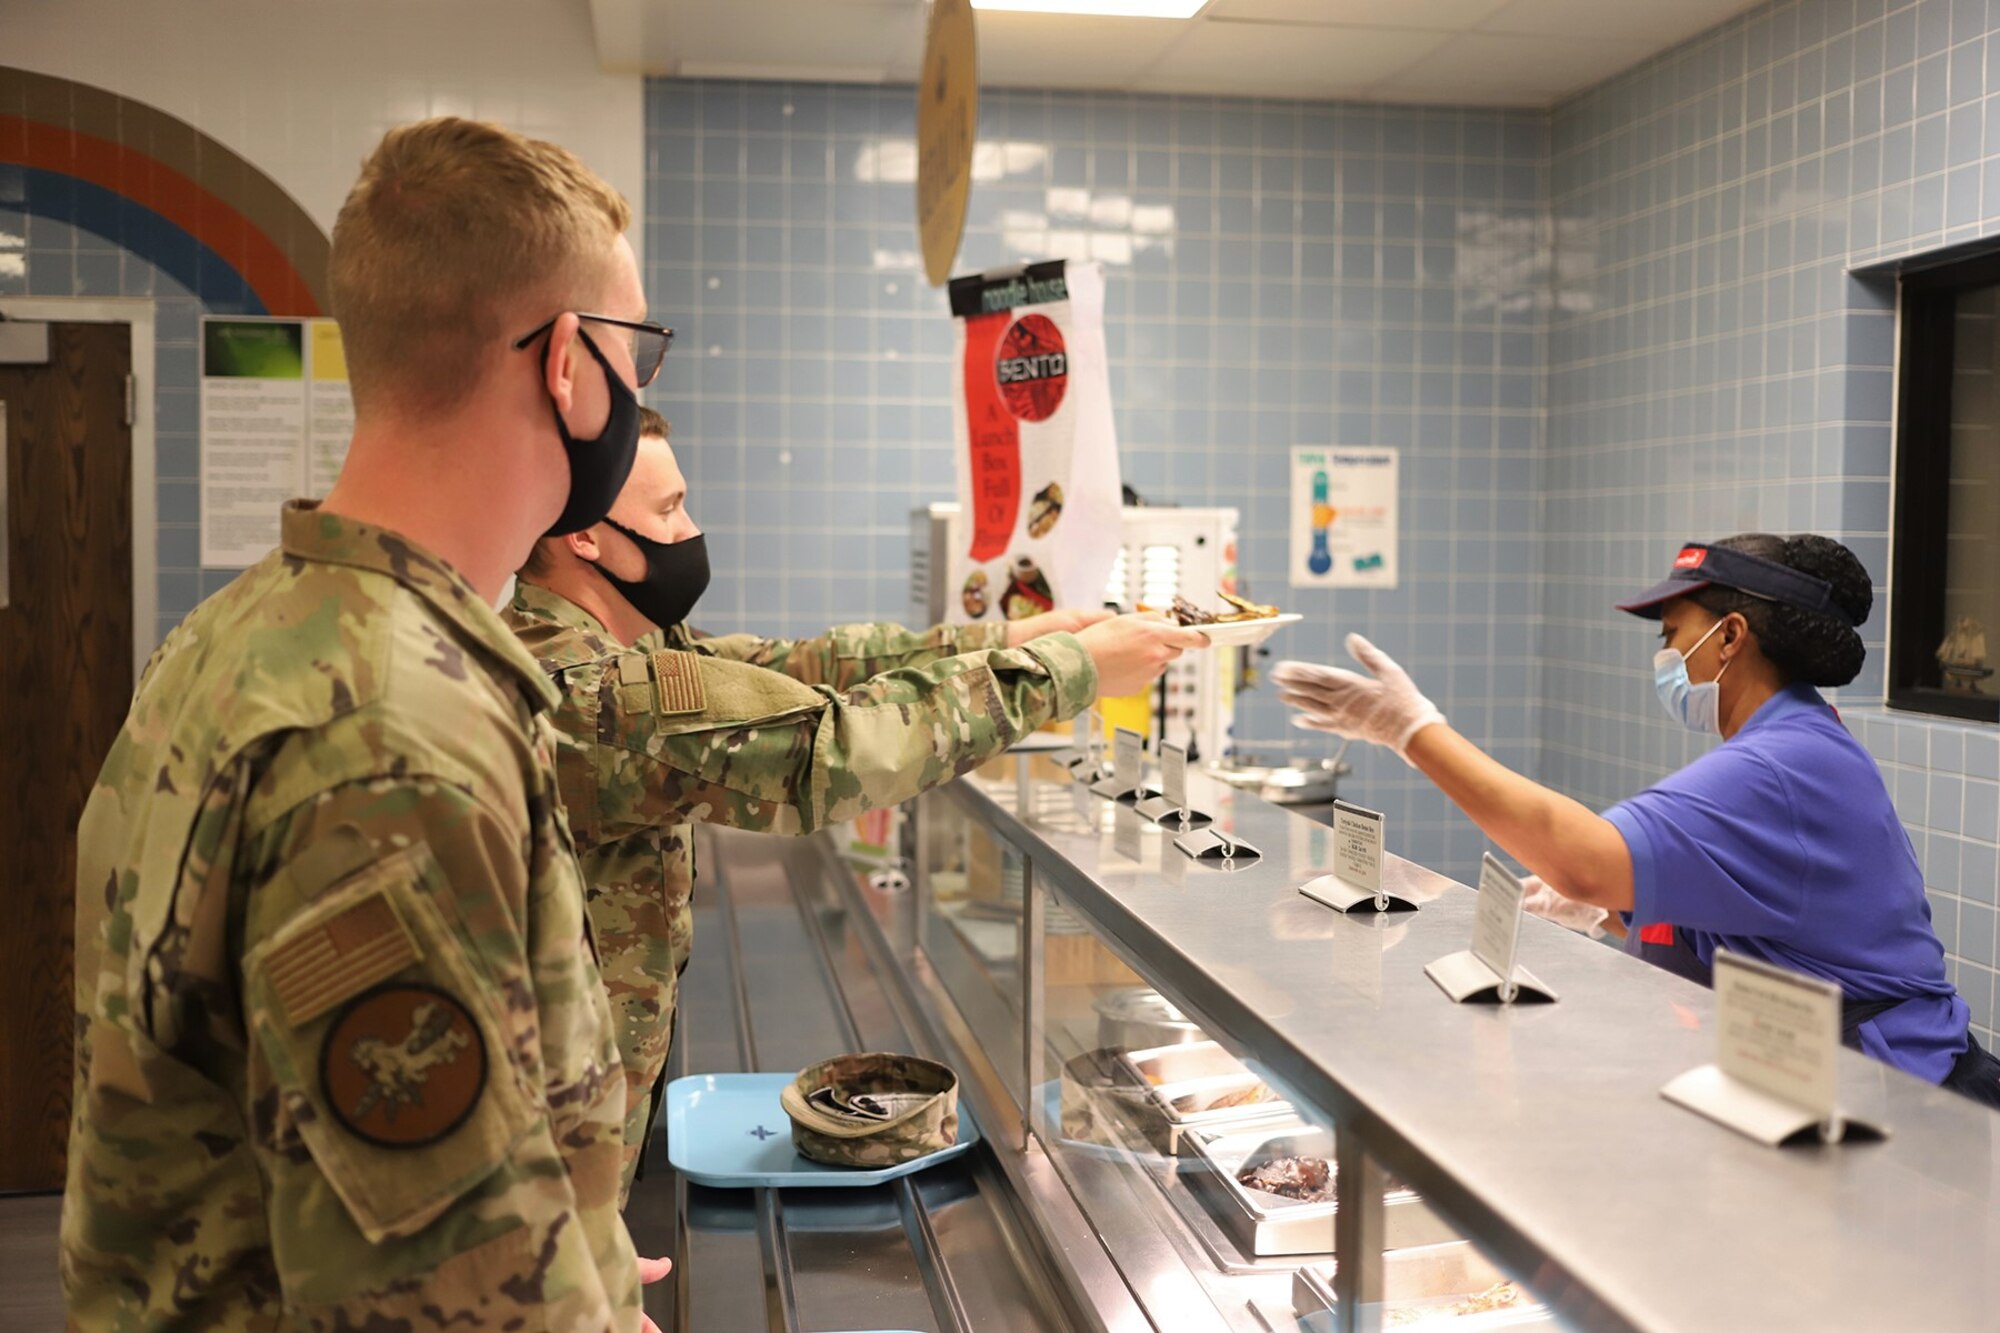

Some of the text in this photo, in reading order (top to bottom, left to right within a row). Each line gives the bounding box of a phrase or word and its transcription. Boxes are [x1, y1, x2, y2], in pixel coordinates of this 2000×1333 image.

[998, 353, 1066, 383] BENTO
[986, 403, 999, 421] A
[982, 452, 1008, 473] Box
